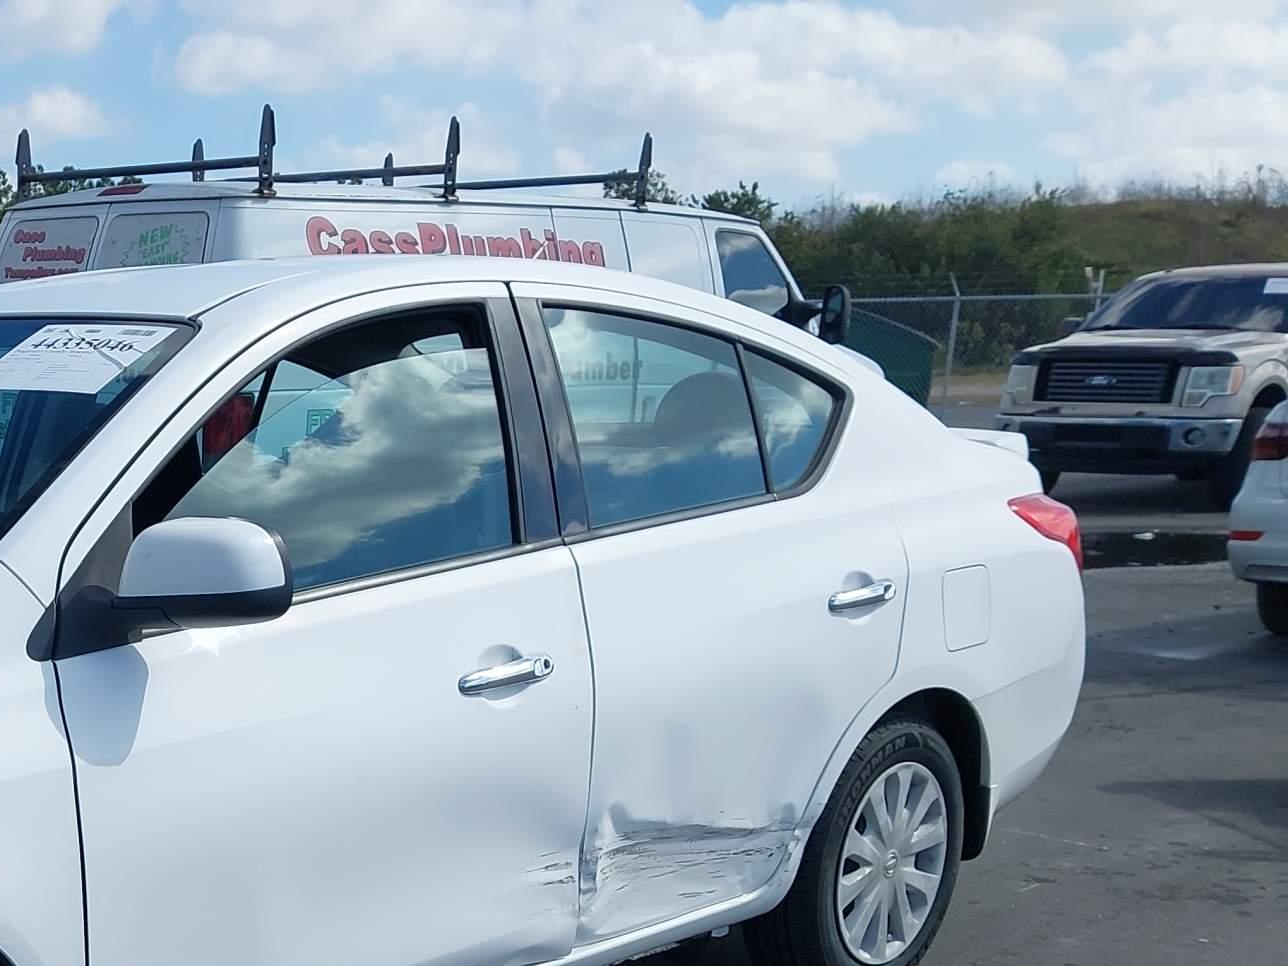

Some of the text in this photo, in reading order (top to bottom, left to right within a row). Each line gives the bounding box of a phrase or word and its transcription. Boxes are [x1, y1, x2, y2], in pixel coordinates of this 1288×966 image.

[138, 223, 174, 249] NEW
[22, 244, 86, 265] Plumbing
[30, 336, 142, 353] 44335046
